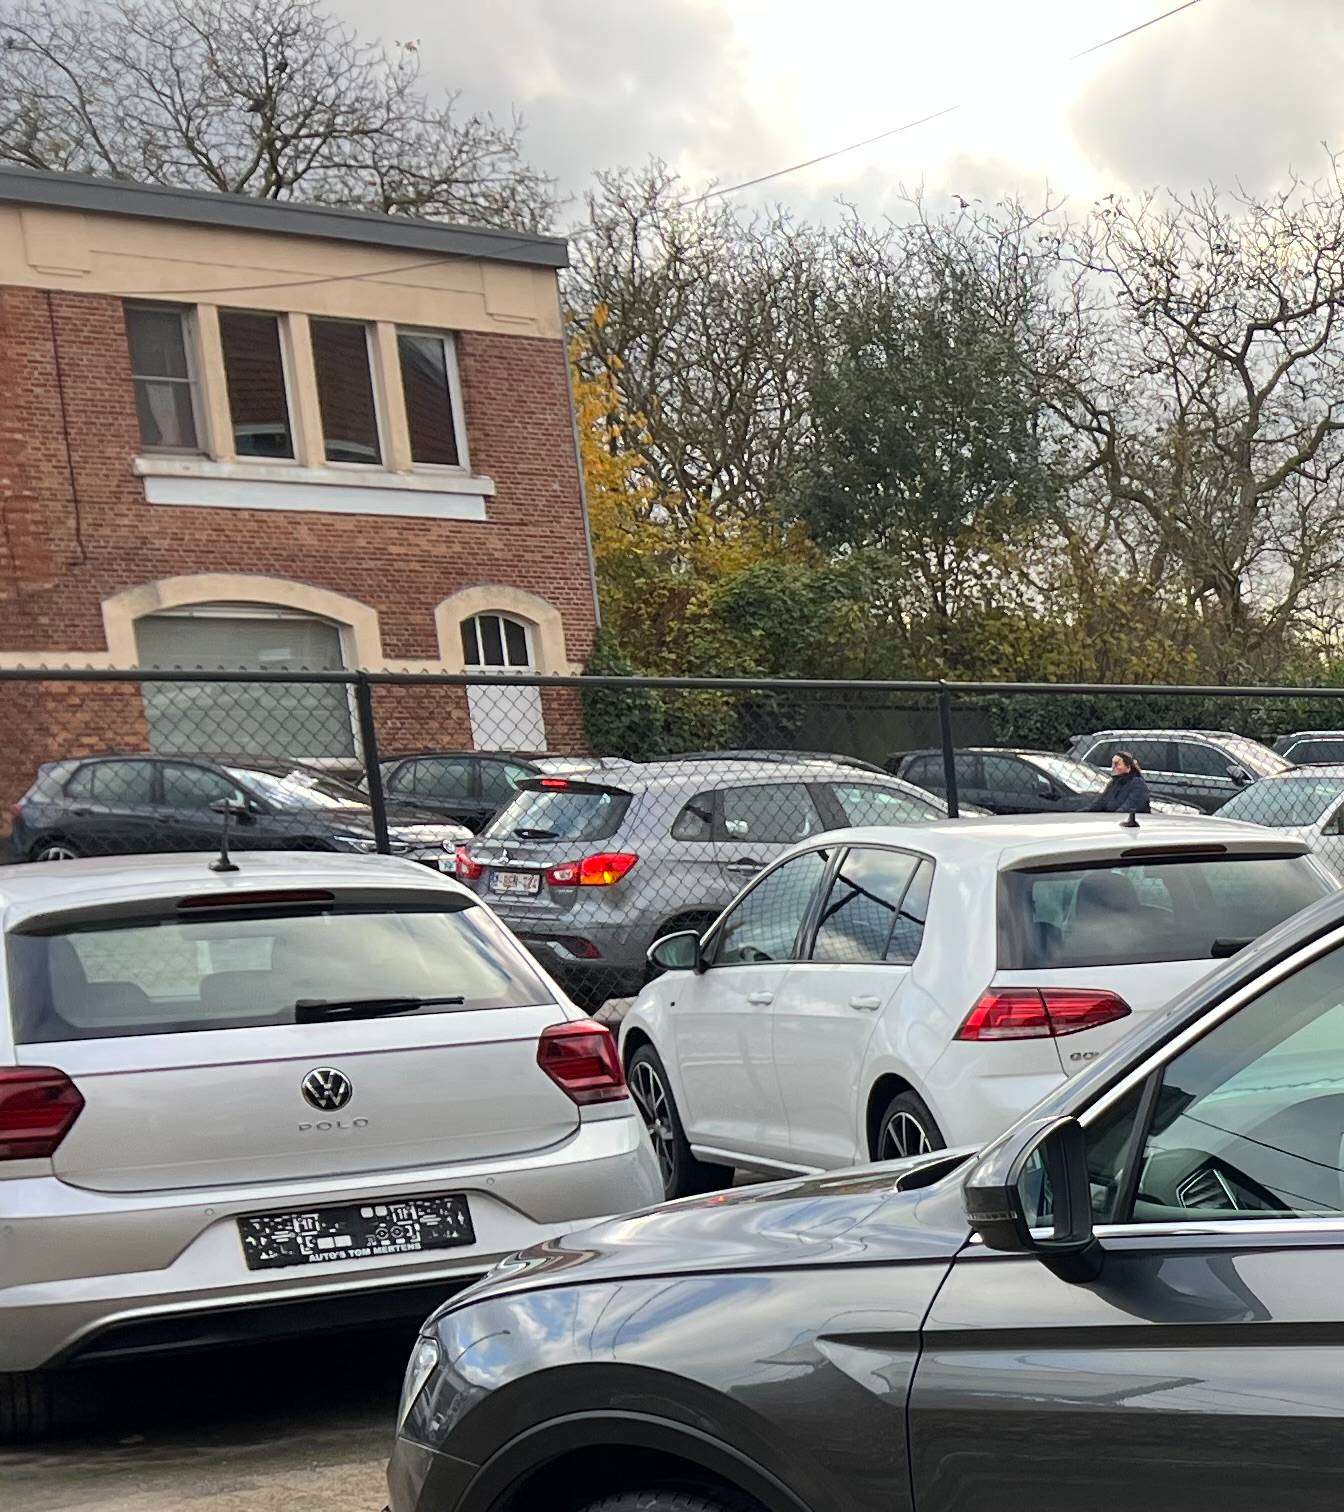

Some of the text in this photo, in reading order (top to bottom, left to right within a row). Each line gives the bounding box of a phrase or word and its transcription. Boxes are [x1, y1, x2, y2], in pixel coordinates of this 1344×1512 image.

[1070, 1051, 1100, 1062] GO
[298, 1117, 369, 1132] POLO
[347, 1247, 372, 1258] TOM
